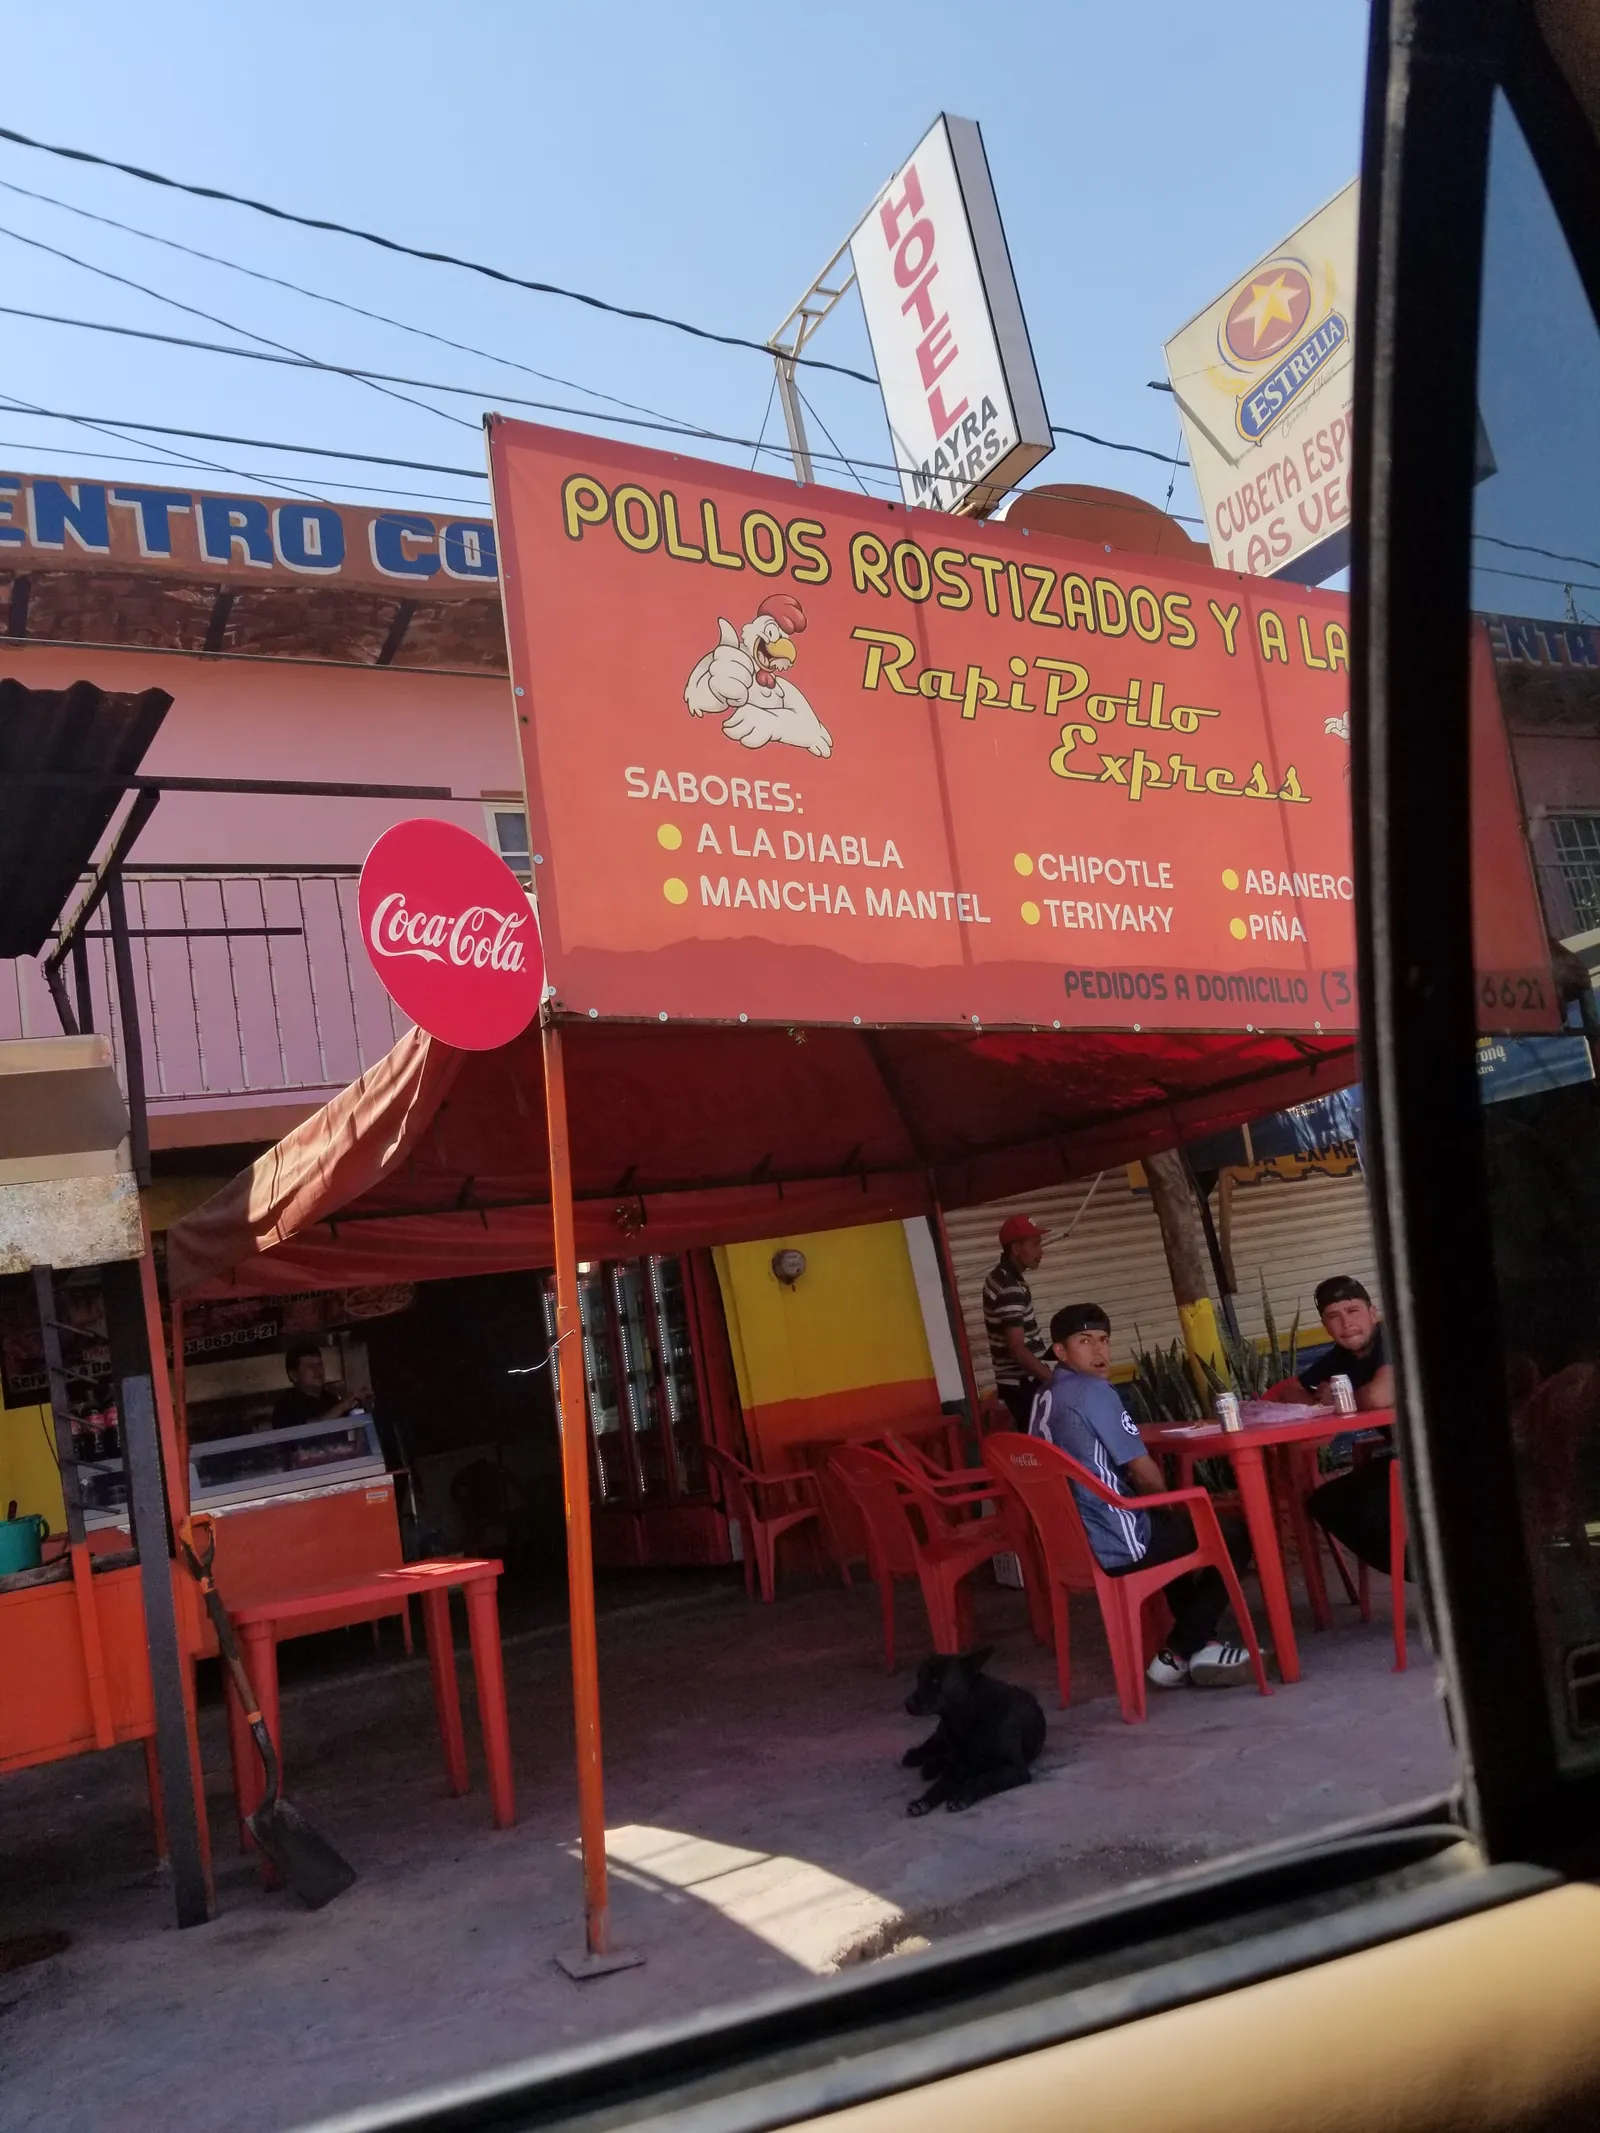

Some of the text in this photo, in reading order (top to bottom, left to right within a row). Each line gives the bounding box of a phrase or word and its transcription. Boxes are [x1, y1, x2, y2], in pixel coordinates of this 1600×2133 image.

[880, 162, 968, 441] HOTEL
[1247, 320, 1341, 430] ESTRELLA
[911, 395, 998, 500] MAYRA
[948, 428, 1008, 499] HRS.
[1215, 455, 1301, 542] CUBETA
[1298, 470, 1351, 534] VE
[561, 473, 1349, 675] POLLOS ROSTIZADOS Y A LA
[624, 766, 804, 814] SABORES:
[1049, 722, 1311, 803] Express
[697, 823, 904, 869] A LA DIABLA
[1038, 853, 1174, 890] CHIPOTLE
[700, 875, 991, 923] MANCHA MANTEL
[1043, 899, 1174, 933] TERIYAKY
[1245, 869, 1353, 901] ABANERO
[370, 892, 528, 973] Coca-Cola
[1249, 910, 1307, 943] PIÑA
[1064, 970, 1168, 1000] PEDIDOS
[1175, 974, 1190, 1000] A
[1196, 975, 1309, 1005] DOMICILIO
